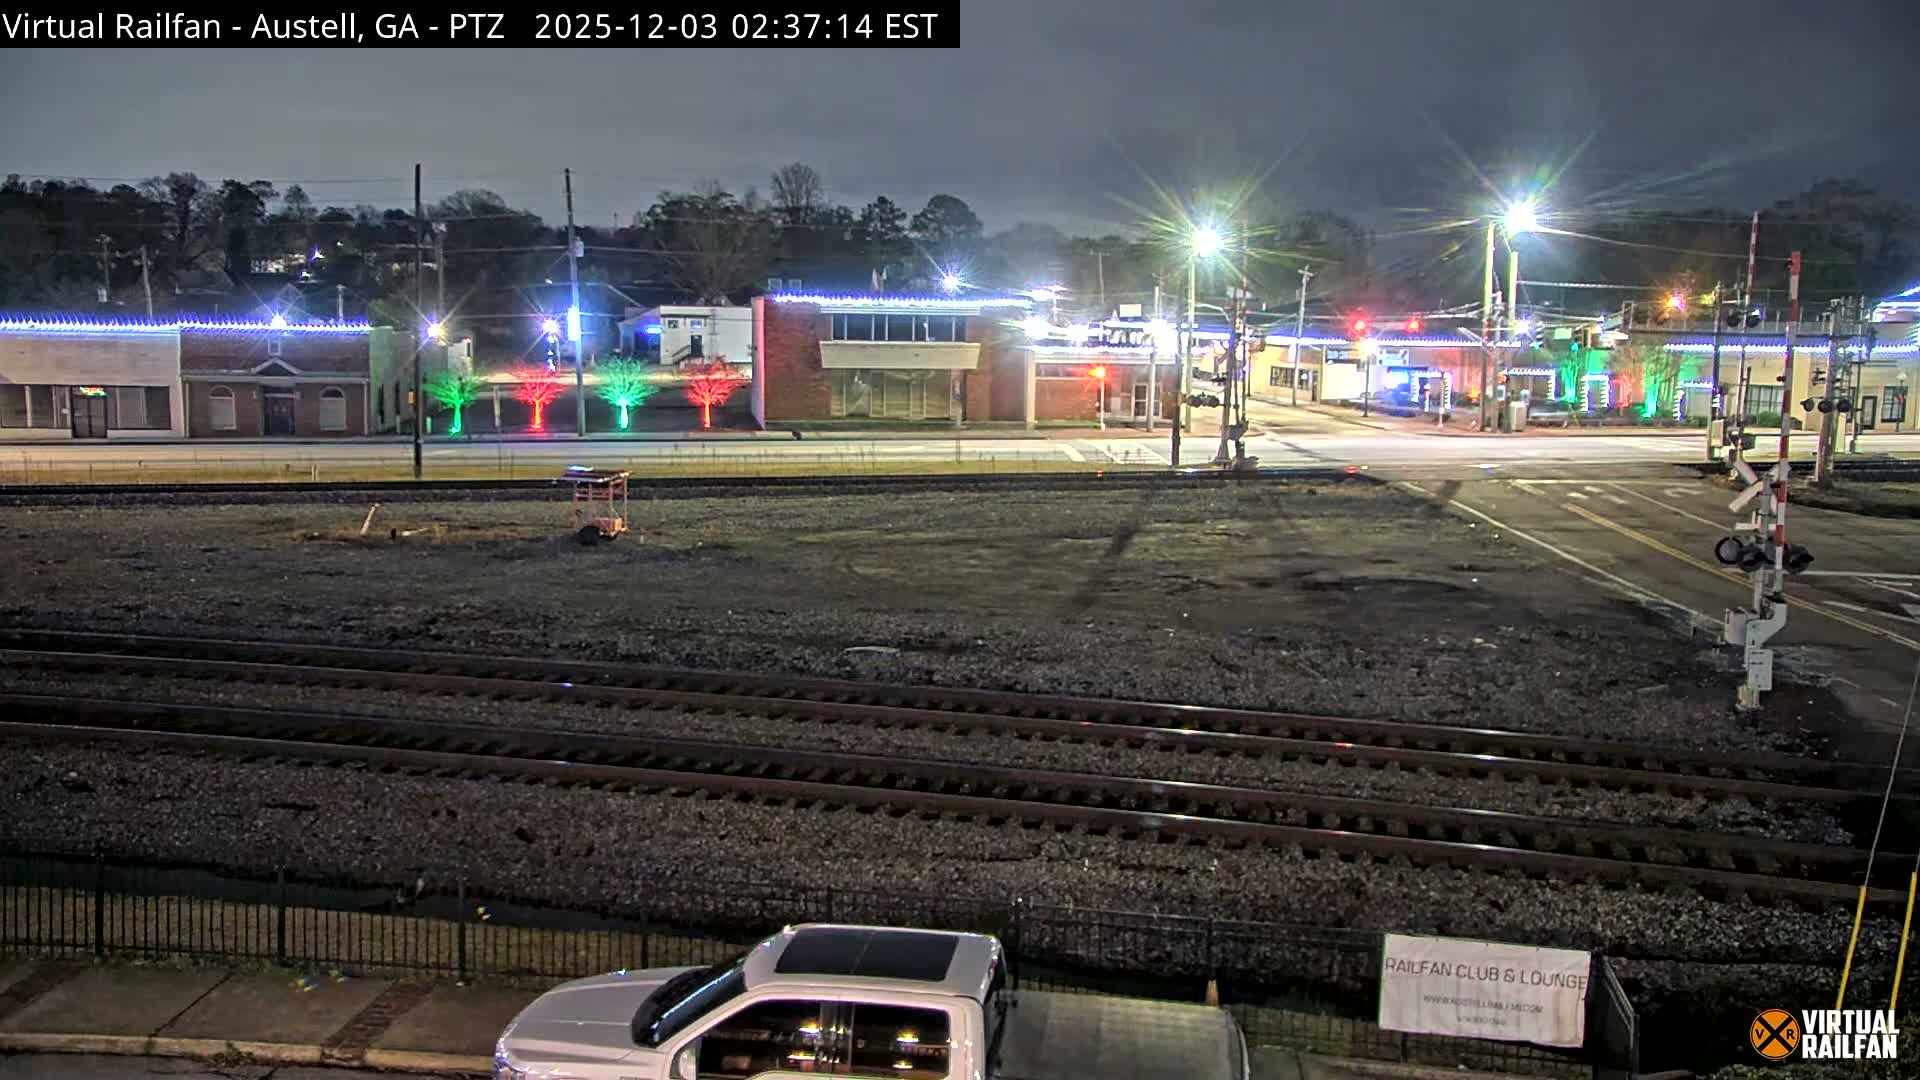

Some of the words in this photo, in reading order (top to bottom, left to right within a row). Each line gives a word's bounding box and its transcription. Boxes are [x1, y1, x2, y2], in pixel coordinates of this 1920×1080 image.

[1385, 957, 1451, 977] RAILFAN
[1456, 964, 1500, 982] CLUB
[1503, 968, 1515, 983] &
[1520, 970, 1587, 990] LOUNGE
